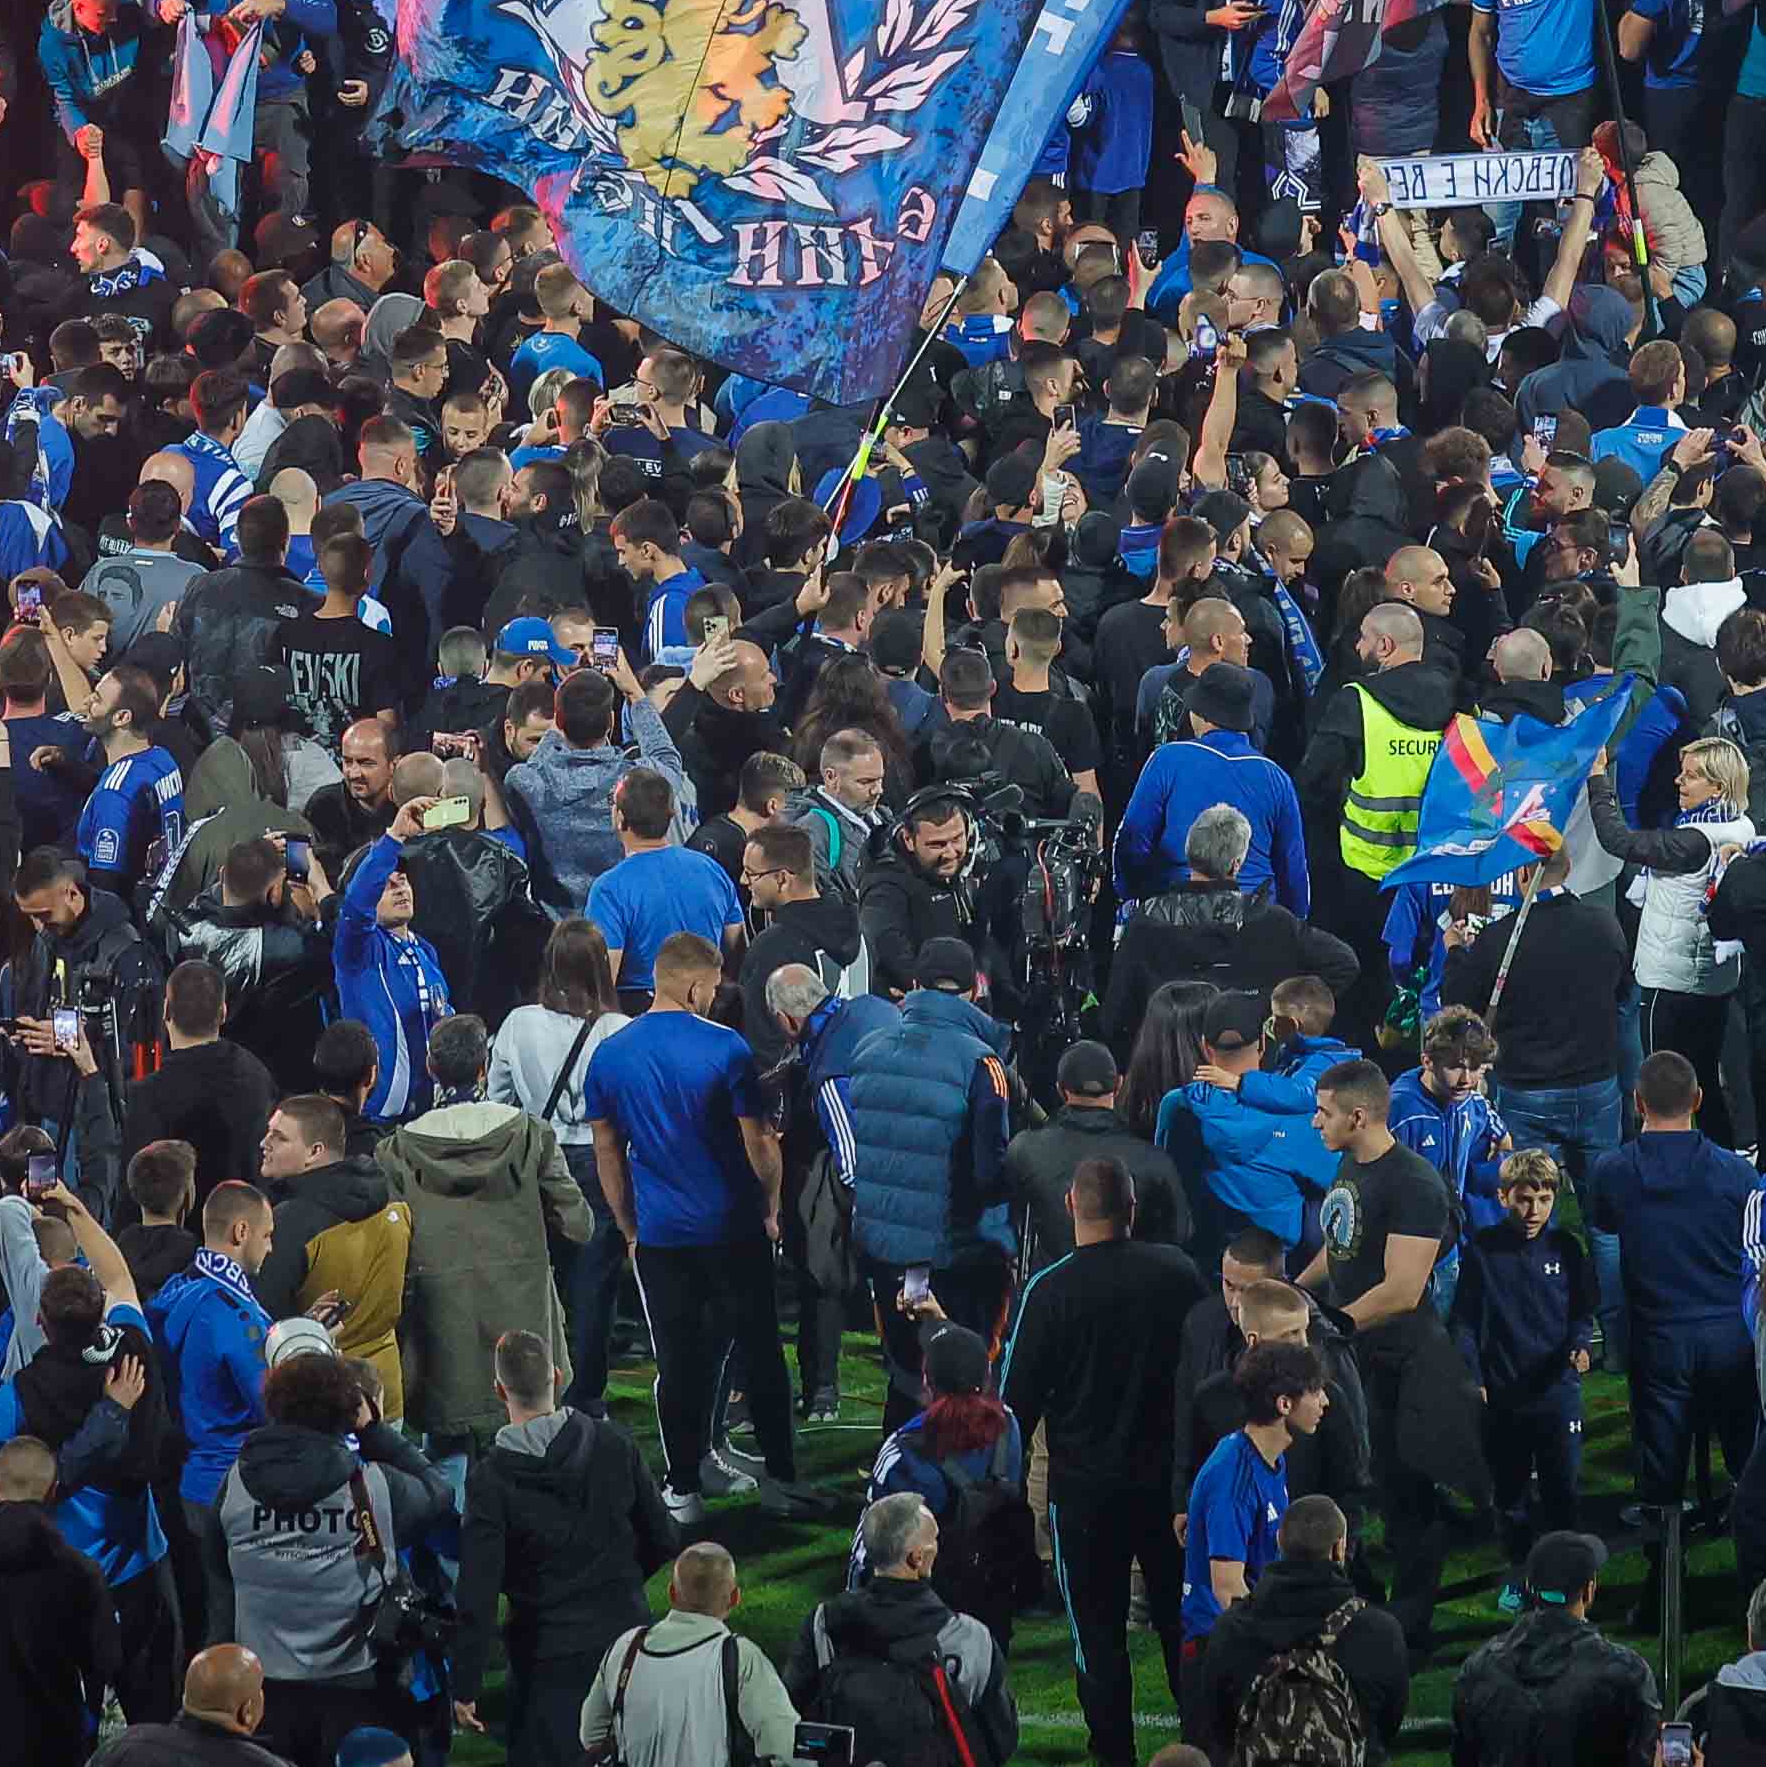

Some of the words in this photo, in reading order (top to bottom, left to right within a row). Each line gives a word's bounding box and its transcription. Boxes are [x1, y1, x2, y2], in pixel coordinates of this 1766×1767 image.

[283, 647, 360, 707] EVSKI
[1388, 739, 1441, 756] SECUR
[356, 1510, 375, 1547] Canon
